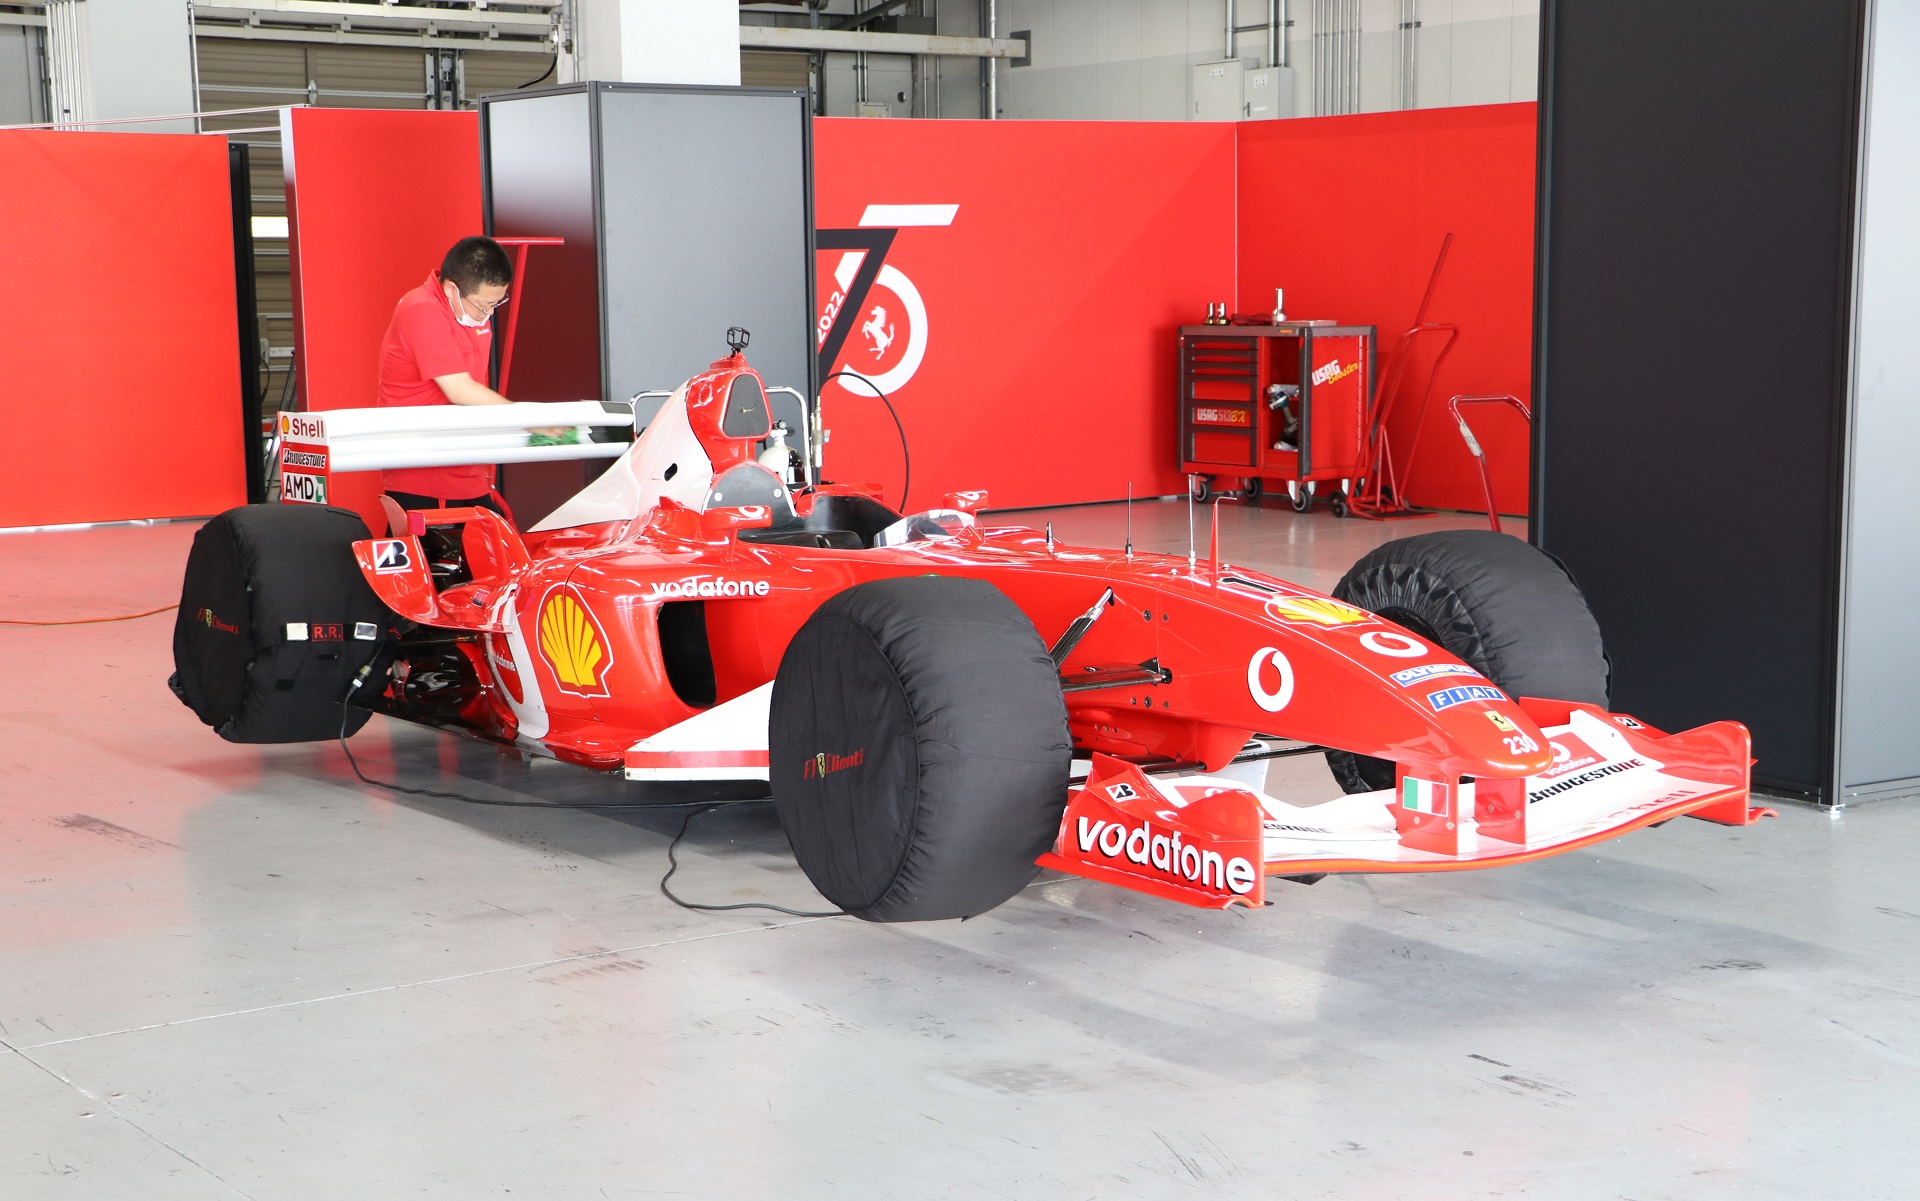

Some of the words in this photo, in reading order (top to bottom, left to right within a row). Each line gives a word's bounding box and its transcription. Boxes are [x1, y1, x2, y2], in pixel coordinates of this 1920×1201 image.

[817, 291, 845, 343] 2022
[1312, 359, 1341, 387] USAG
[1327, 362, 1359, 385] Booster
[1197, 408, 1218, 423] USAG
[292, 417, 325, 438] Shell
[283, 448, 326, 468] BRIDGESTONE
[284, 474, 315, 500] AMD
[651, 576, 770, 598] vodafone
[313, 626, 342, 639] R.R.
[1433, 686, 1501, 706] FIAT
[1502, 735, 1539, 755] 230
[825, 748, 864, 774] Clienti
[1546, 755, 1596, 776] vodafone
[1529, 758, 1645, 804] BRIDGESTONE
[1077, 815, 1256, 894] vodafone
